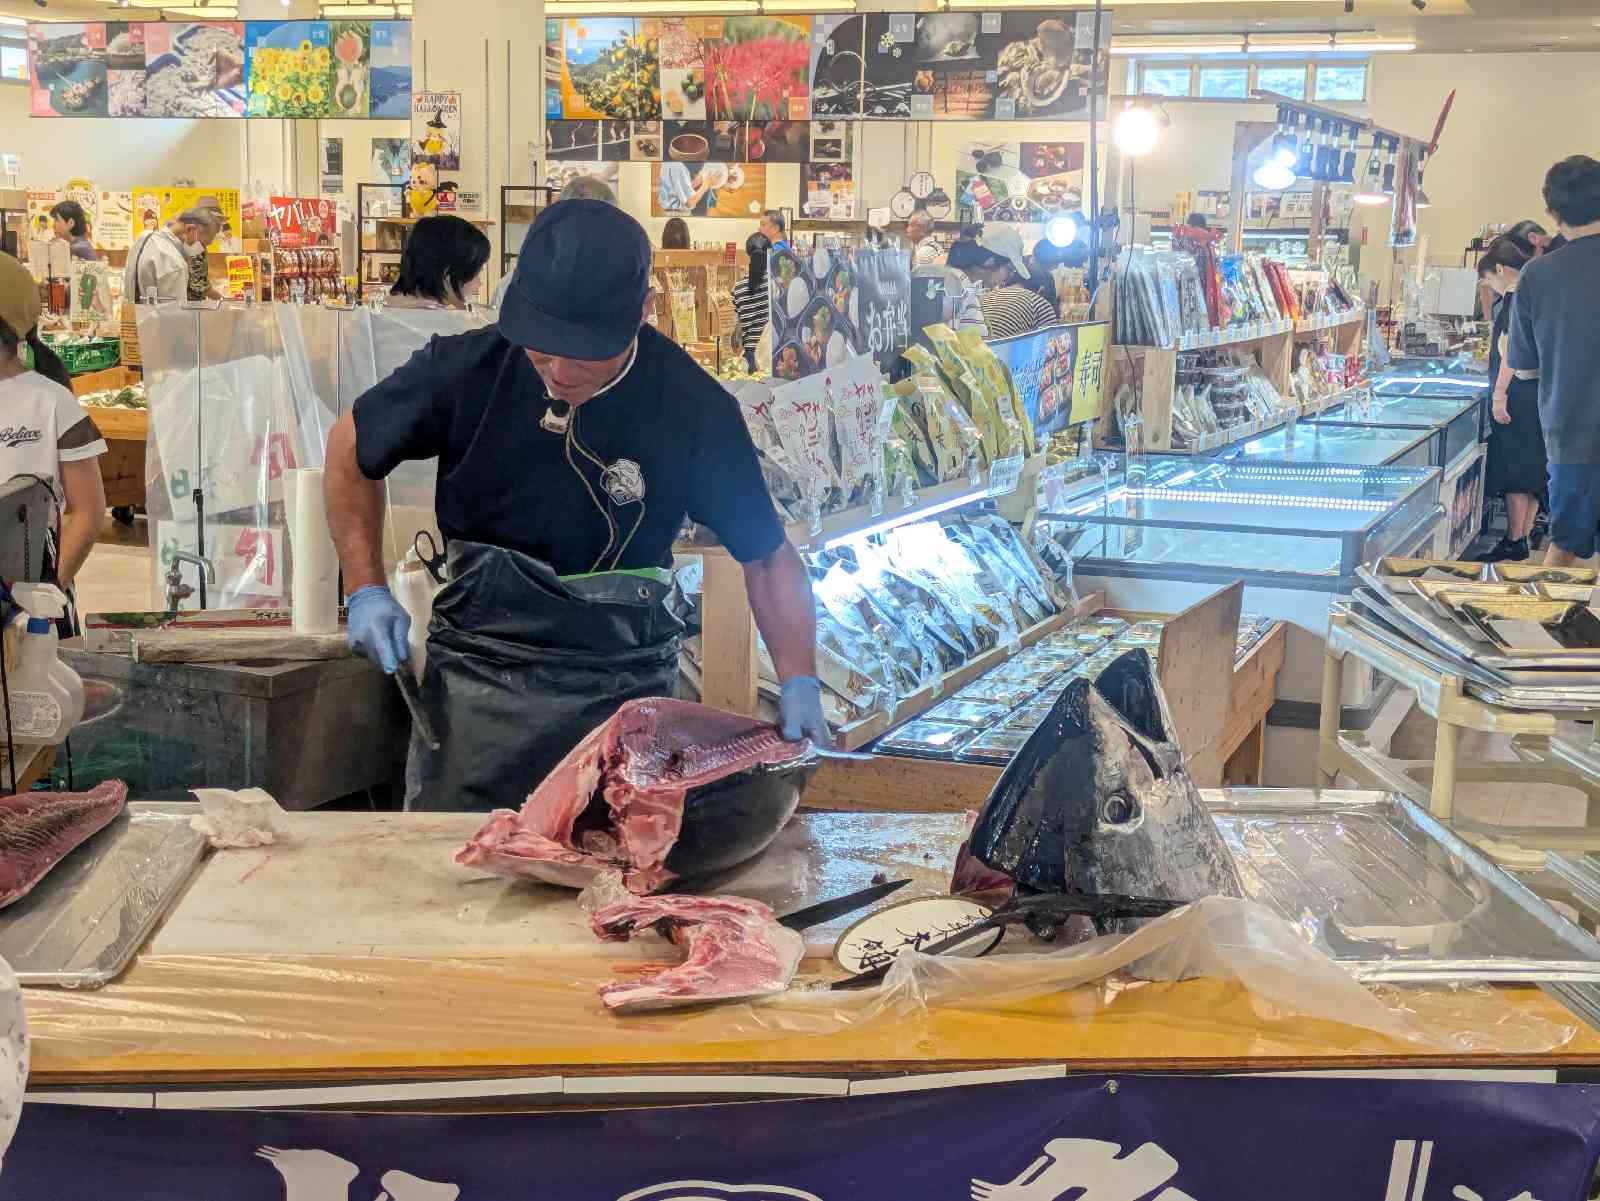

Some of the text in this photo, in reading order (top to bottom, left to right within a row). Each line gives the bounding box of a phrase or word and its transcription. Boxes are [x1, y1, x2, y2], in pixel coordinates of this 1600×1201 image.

[866, 300, 908, 353] お弁当
[1078, 349, 1103, 400] 寿司
